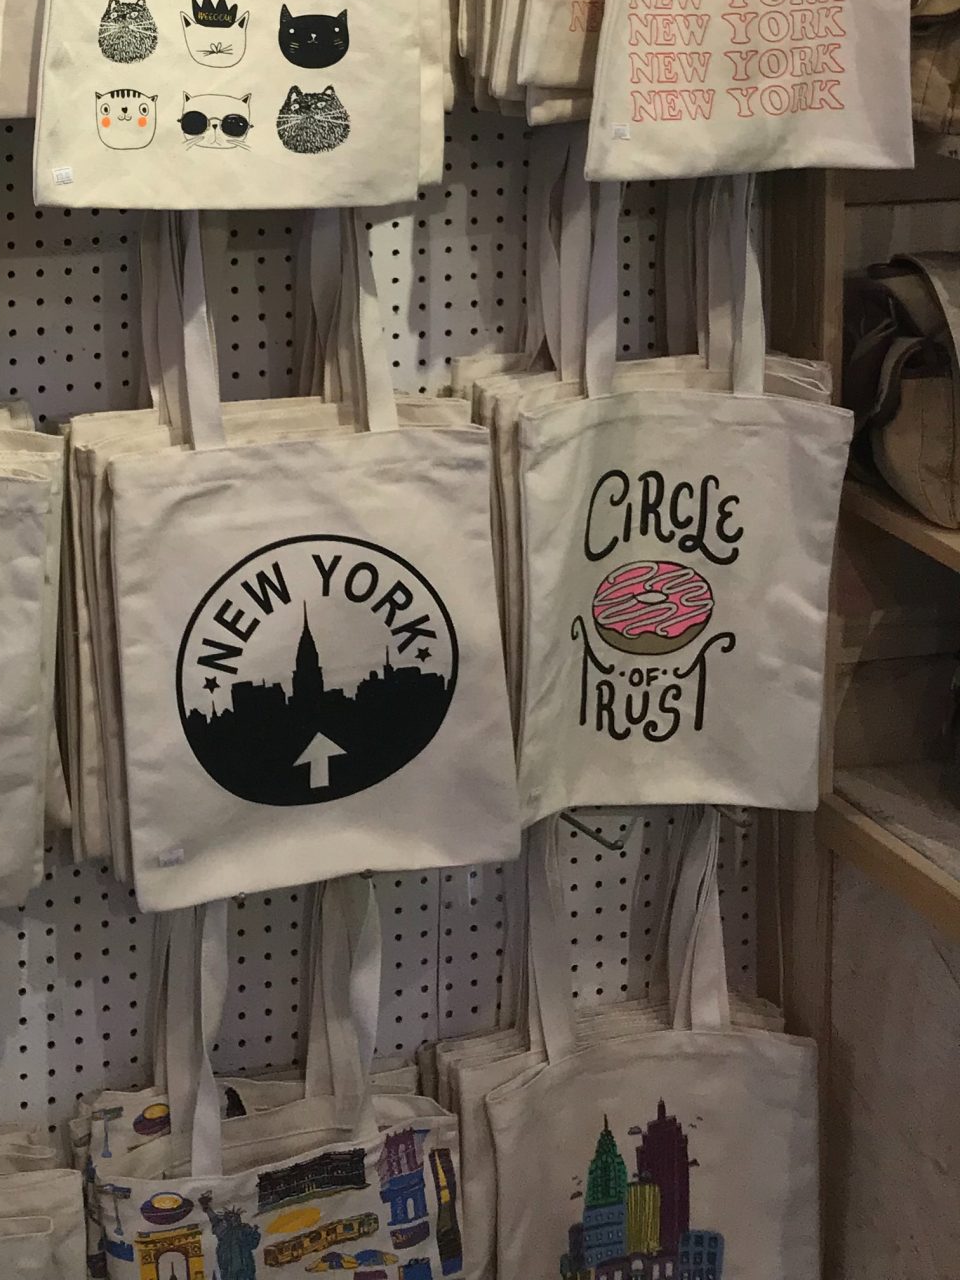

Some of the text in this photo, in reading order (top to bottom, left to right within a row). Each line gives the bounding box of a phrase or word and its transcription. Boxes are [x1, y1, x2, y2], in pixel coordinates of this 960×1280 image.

[628, 6, 847, 47] NEW YORK
[629, 43, 846, 84] NEW YORK
[630, 80, 845, 122] NEW YORK
[196, 554, 438, 674] NEW YORK
[571, 615, 736, 742] TRUST
[629, 668, 660, 687] OF
